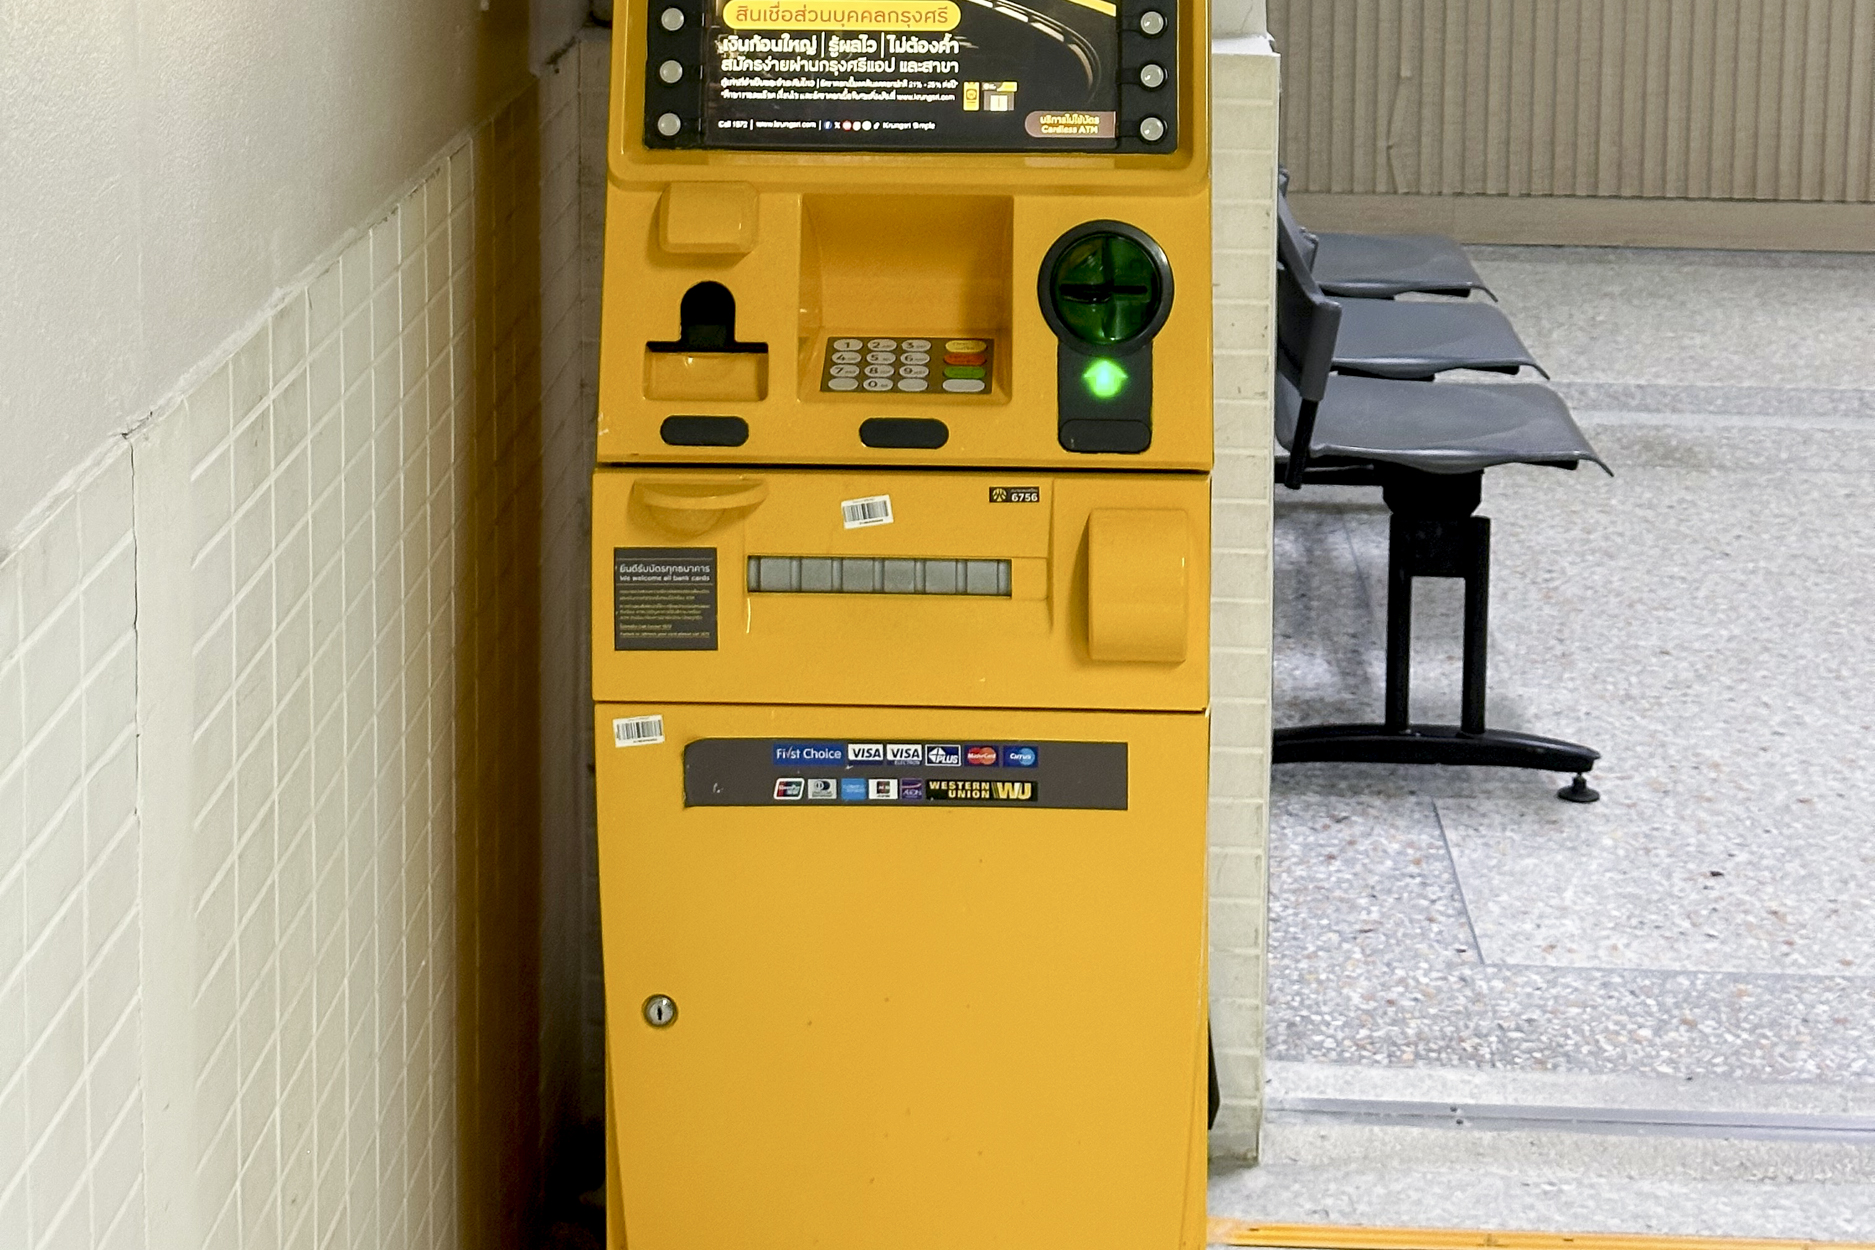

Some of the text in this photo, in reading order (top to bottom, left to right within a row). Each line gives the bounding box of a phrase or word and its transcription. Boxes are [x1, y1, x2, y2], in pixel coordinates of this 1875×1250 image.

[736, 2, 949, 28] สินเชื่อส่วนบุคคลกรุงศรี
[722, 32, 960, 58] เงินก้อนใหญ่ รู้ผลไว ไม่ต้องค้ำ
[721, 57, 960, 77] สมัครง่ายผ่านกรุงศรีแอป และสาขา
[1041, 125, 1098, 134] Cardless ATM
[1011, 493, 1038, 501] 6756
[619, 563, 711, 575] ยินดีรับบัตรทุกธนาคาร
[803, 747, 842, 759] Choice
[853, 748, 882, 759] VISA
[891, 748, 920, 759] VISA
[936, 754, 959, 764] PLUS
[929, 781, 990, 790] WESTERN
[997, 782, 1032, 800] WU
[948, 790, 990, 798] UNION
